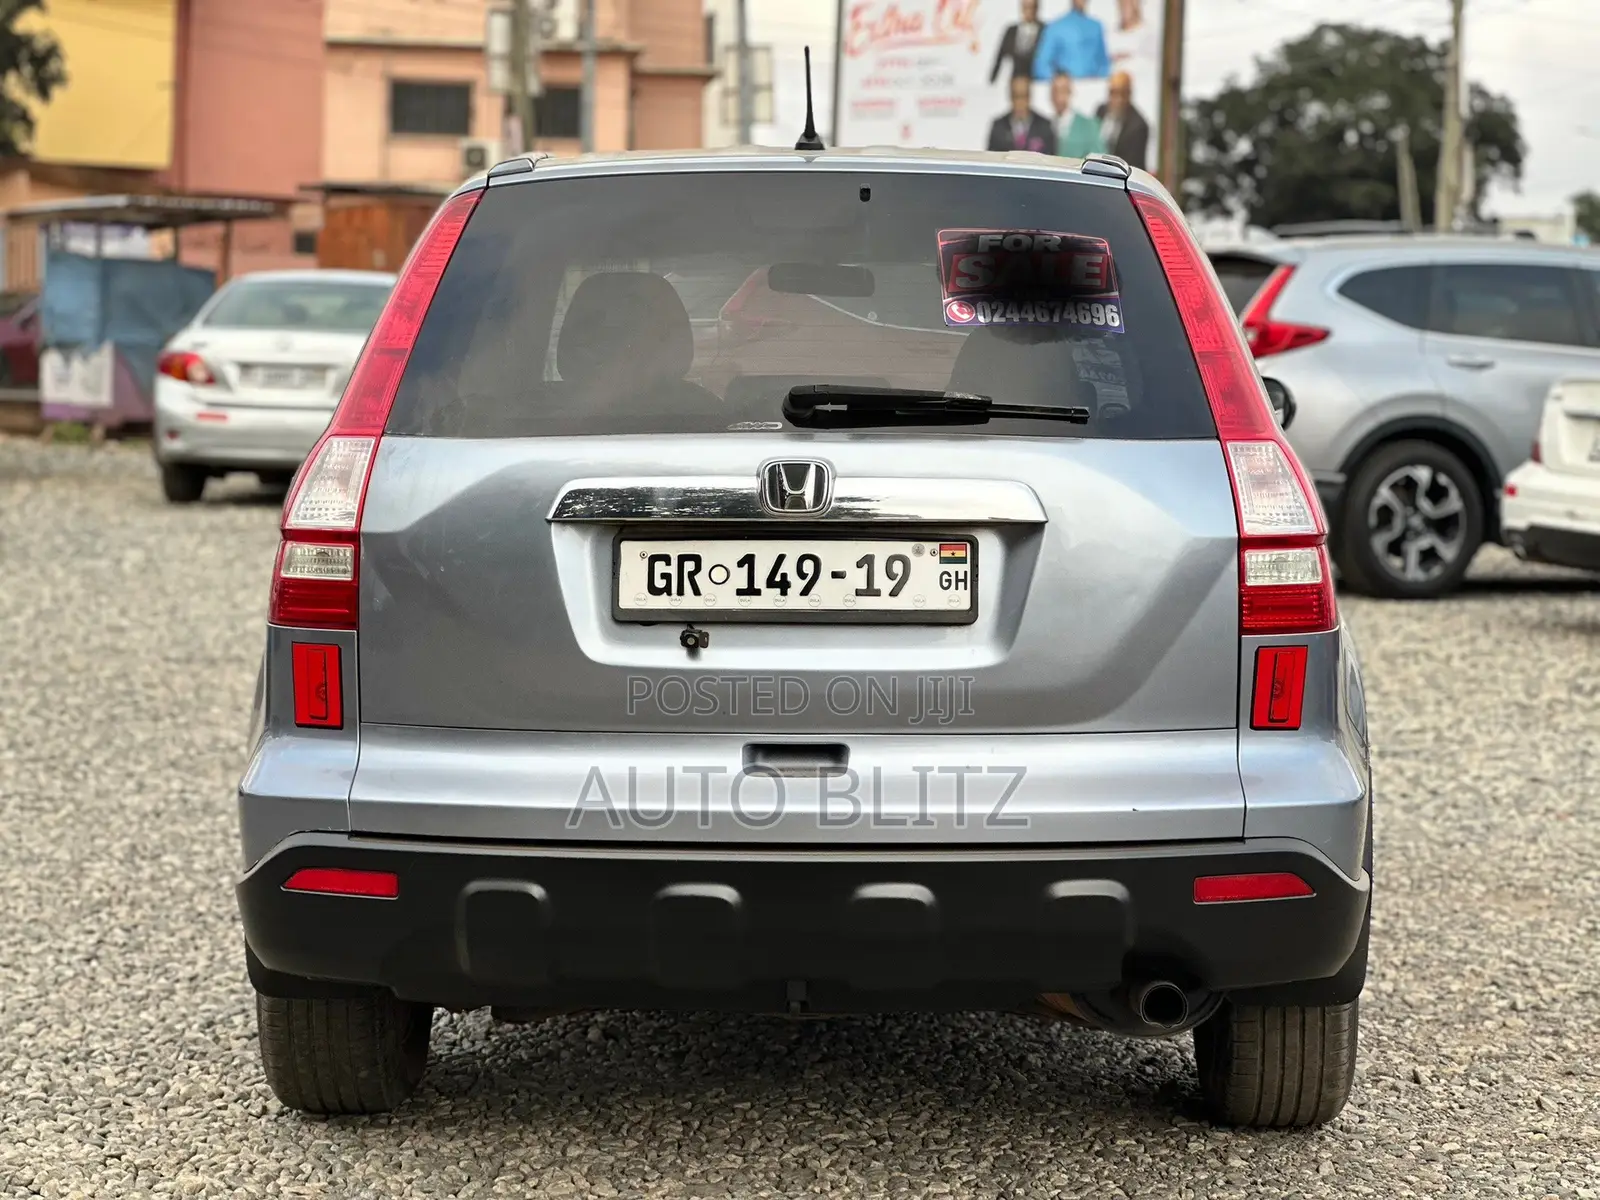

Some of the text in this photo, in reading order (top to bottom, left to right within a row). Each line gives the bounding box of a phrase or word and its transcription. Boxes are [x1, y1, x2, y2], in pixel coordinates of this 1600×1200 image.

[977, 233, 1062, 252] FOR
[955, 254, 1103, 288] SALE
[976, 301, 1120, 327] 0244674696
[647, 553, 703, 597] GR
[939, 570, 968, 591] GH
